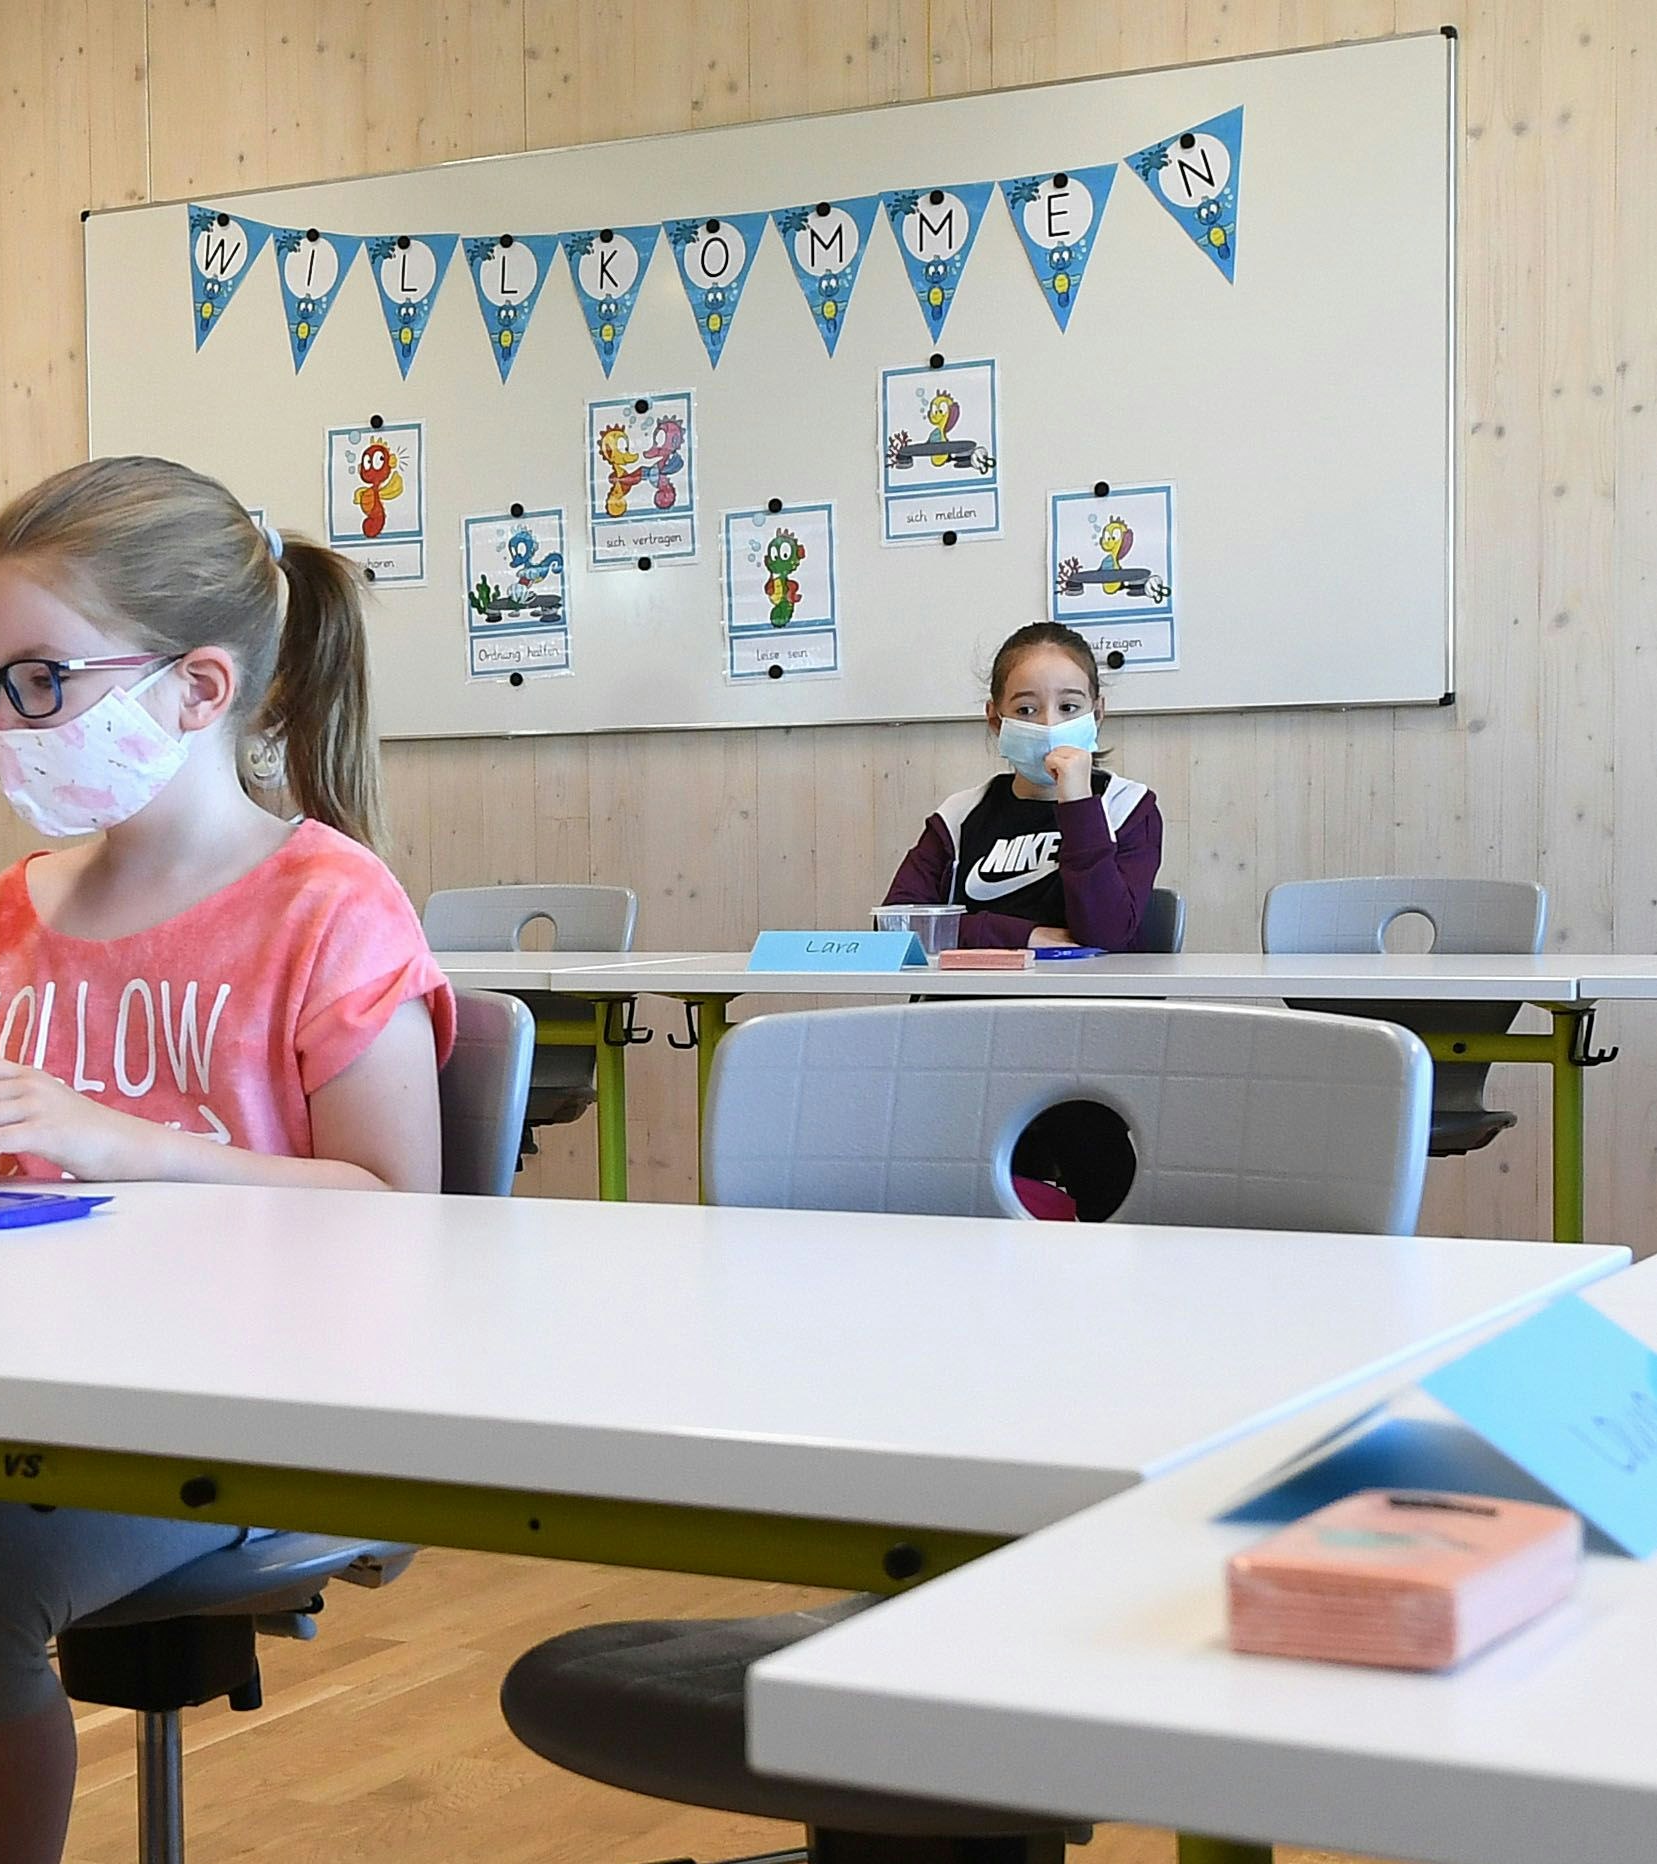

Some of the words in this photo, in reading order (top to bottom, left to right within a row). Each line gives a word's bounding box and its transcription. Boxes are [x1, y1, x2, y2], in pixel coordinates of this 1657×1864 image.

[906, 509, 928, 524] sich
[935, 506, 978, 521] melden
[606, 535, 626, 548] sich
[632, 532, 683, 547] vertragen
[1089, 636, 1143, 653] ufzeigen
[478, 648, 522, 663] Ordnung
[527, 644, 560, 658] halten
[756, 648, 780, 662] leise
[787, 649, 809, 660] sein
[980, 831, 1062, 873] NIKE
[806, 940, 860, 954] Lara
[5, 1454, 43, 1478] VS
